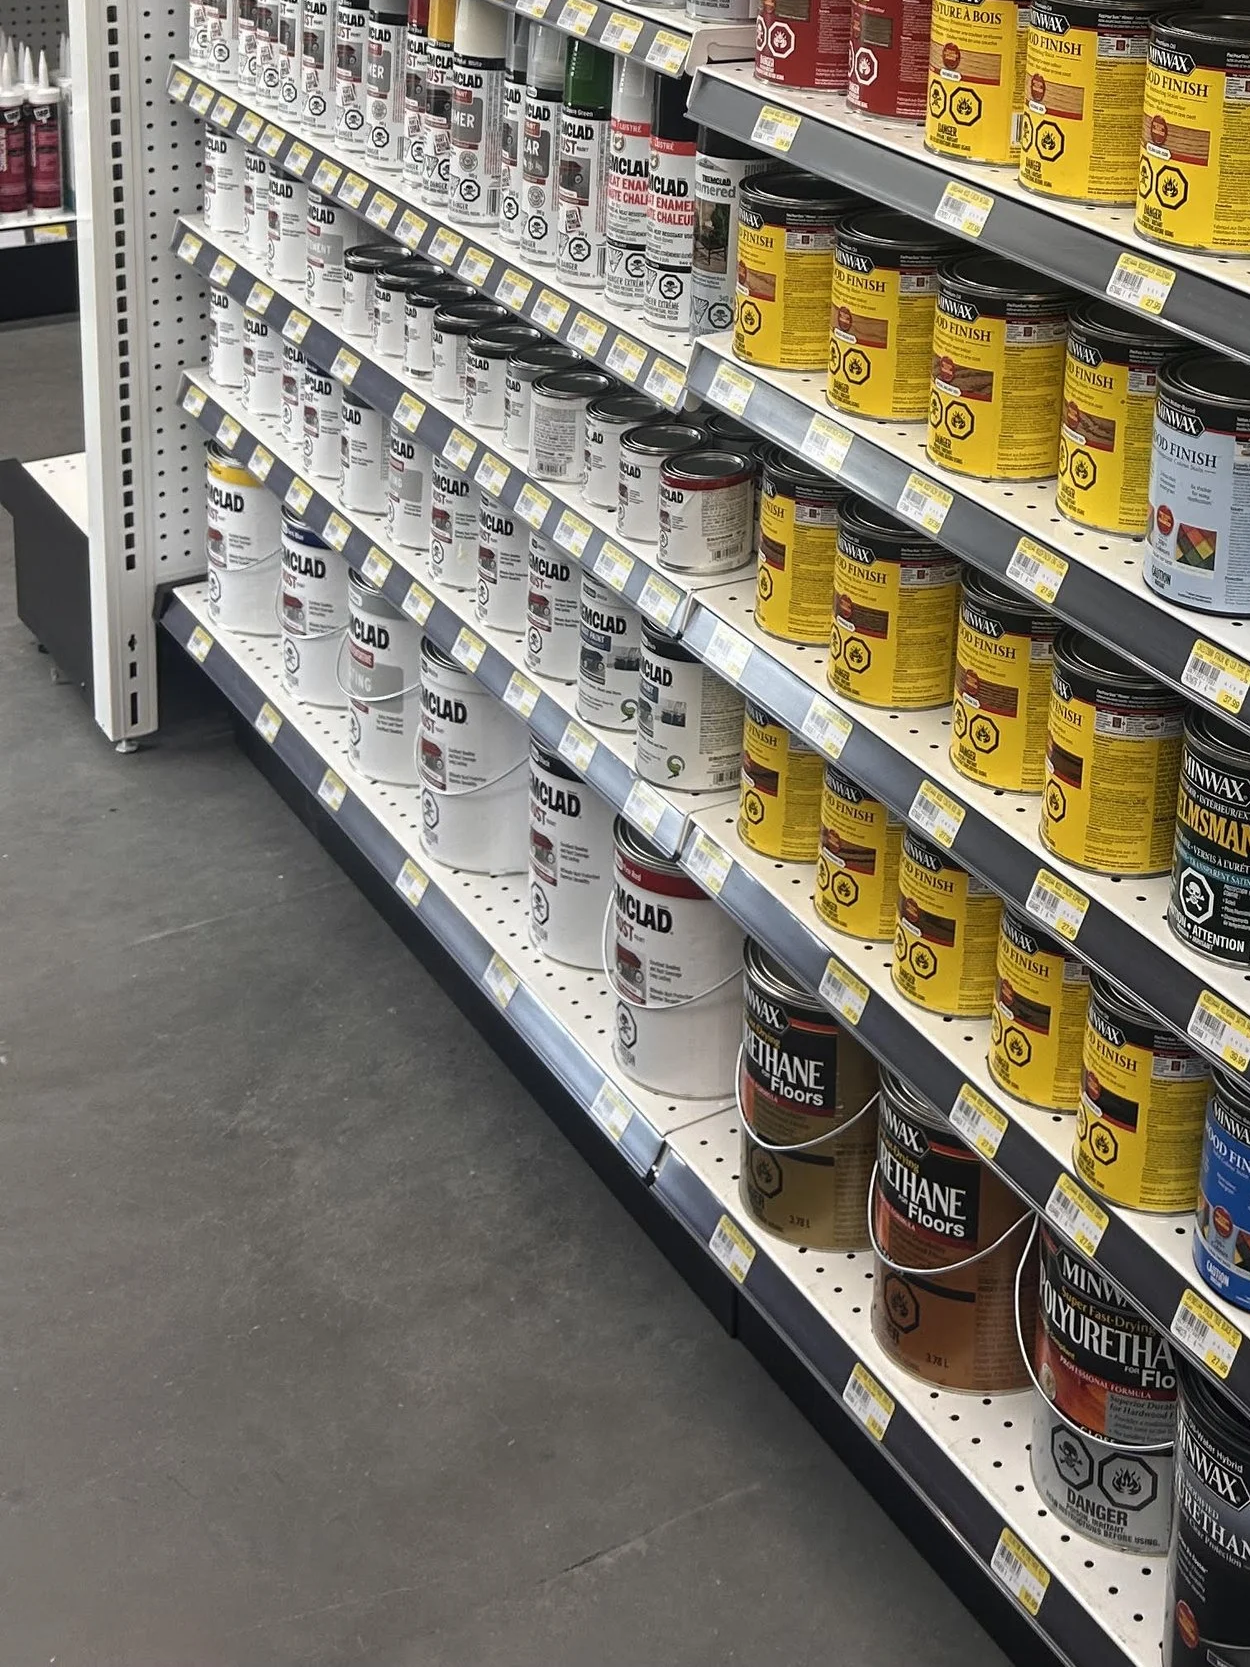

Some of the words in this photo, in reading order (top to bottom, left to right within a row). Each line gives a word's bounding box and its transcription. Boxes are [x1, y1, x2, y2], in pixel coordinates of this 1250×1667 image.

[977, 9, 1001, 25] BOIS
[772, 1076, 823, 1107] Floors
[909, 1205, 965, 1238] Floors
[1060, 1355, 1108, 1389] PROFESSIONAL
[1110, 1384, 1151, 1399] FORMULA
[1217, 1449, 1243, 1473] Hybrid
